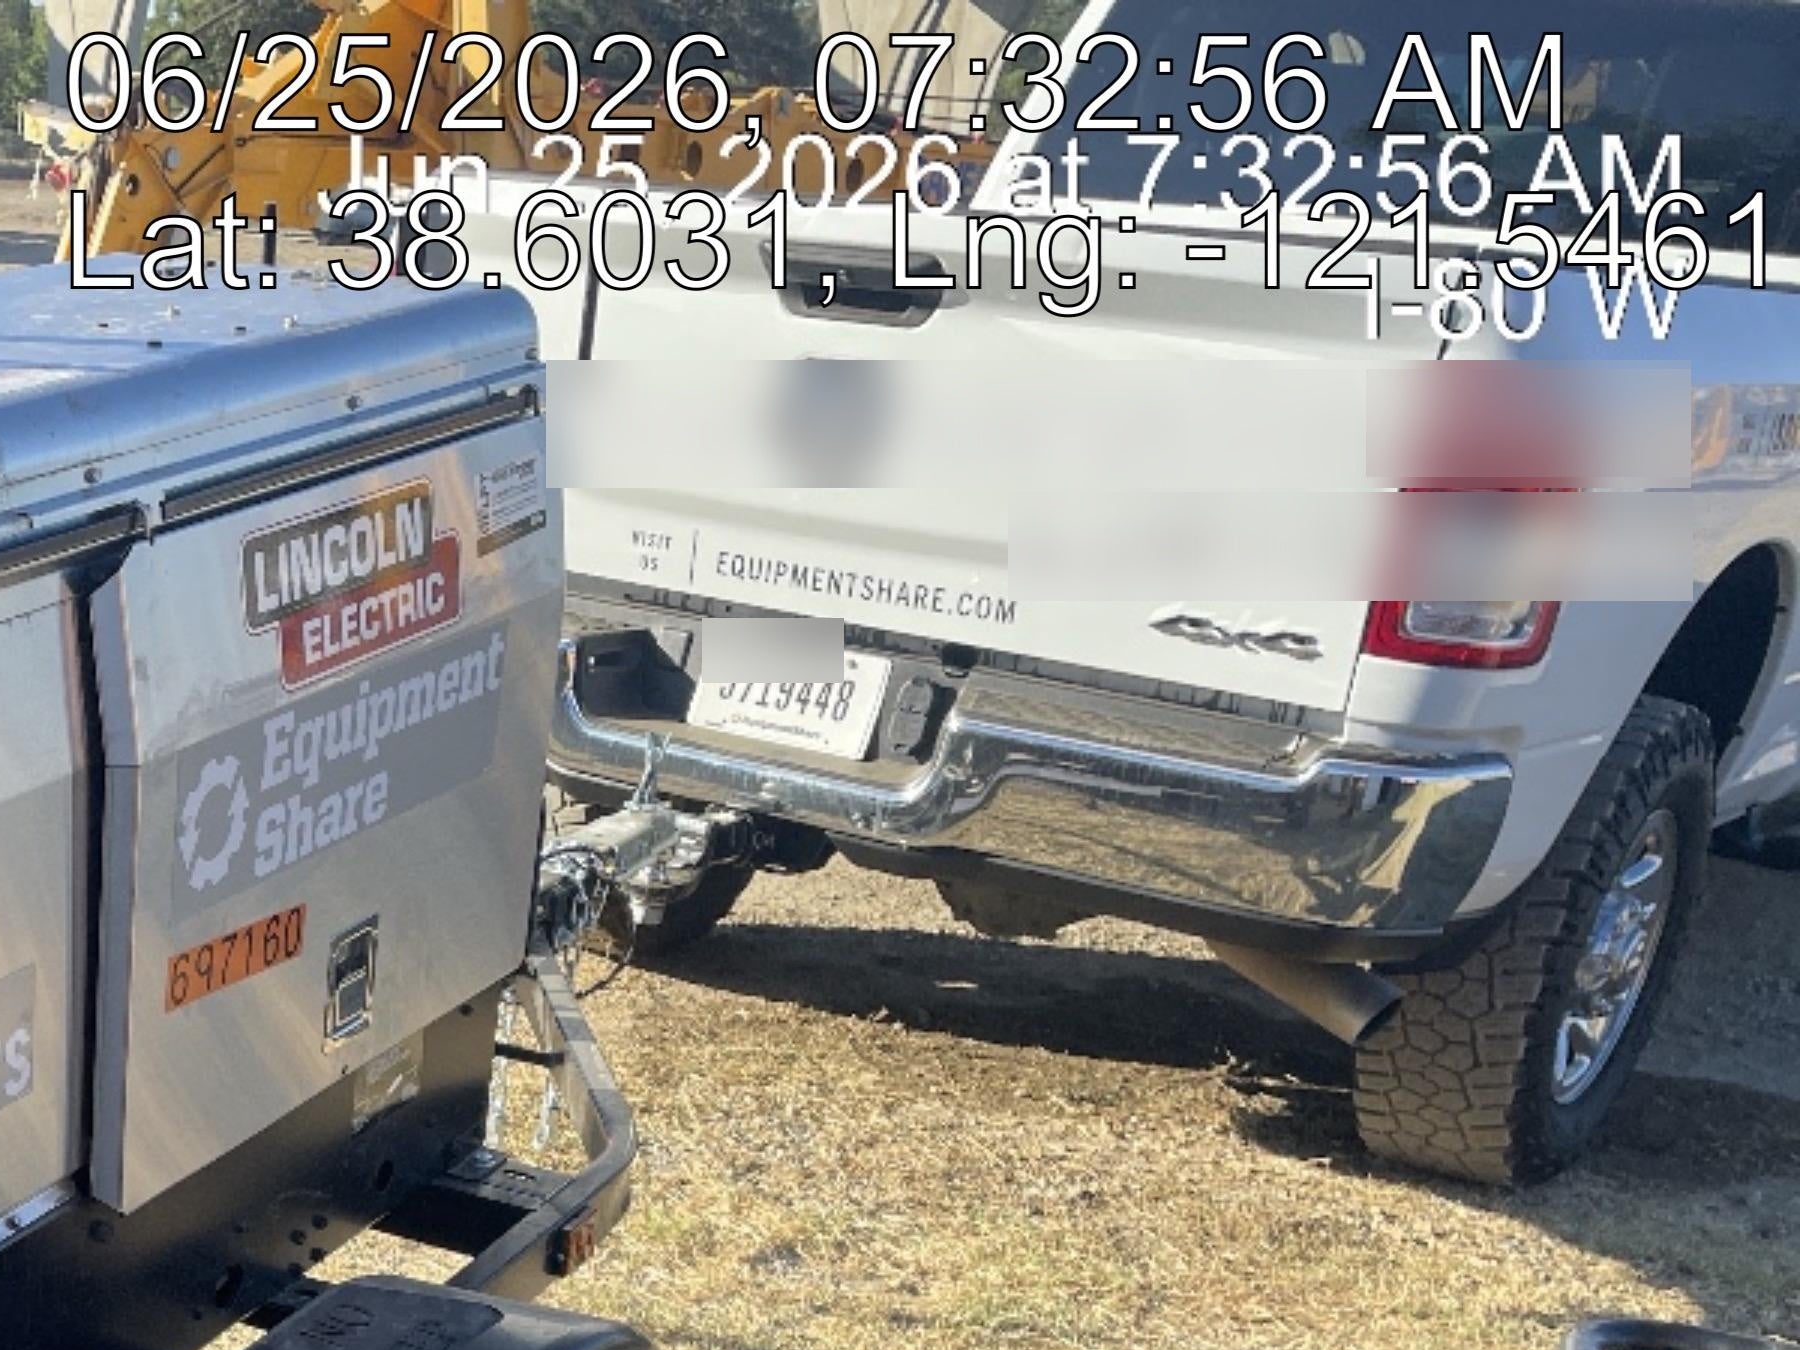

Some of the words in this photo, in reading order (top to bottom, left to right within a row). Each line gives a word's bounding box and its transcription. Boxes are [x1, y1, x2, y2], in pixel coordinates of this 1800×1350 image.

[253, 496, 426, 614] LINCOLN
[716, 550, 1018, 625] EQUIPMENTSHARE.COM
[302, 571, 447, 666] ELECTRIC
[261, 632, 505, 792] Equipment
[254, 769, 389, 878] Share
[170, 907, 303, 1007] 697160
